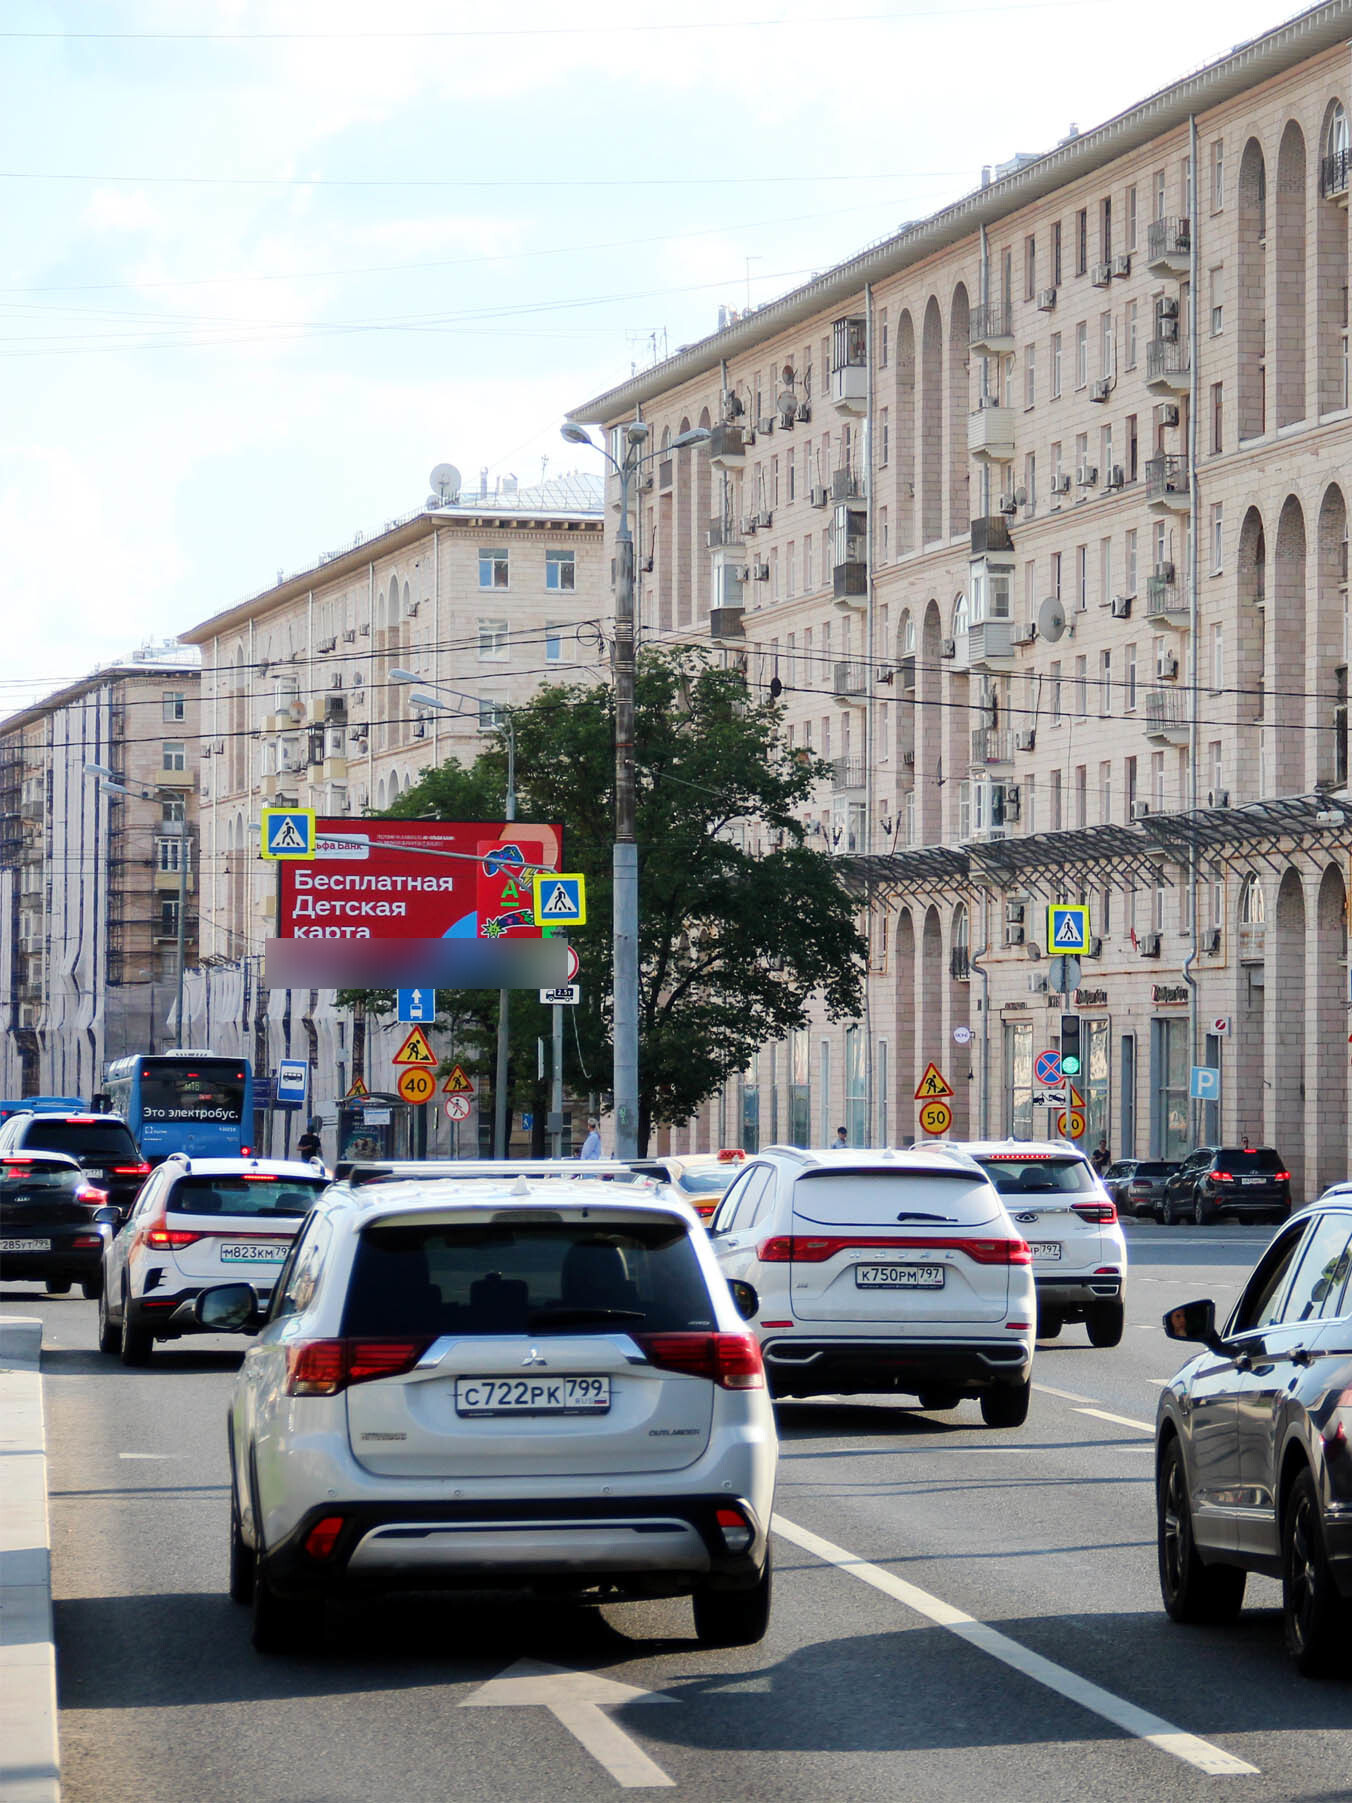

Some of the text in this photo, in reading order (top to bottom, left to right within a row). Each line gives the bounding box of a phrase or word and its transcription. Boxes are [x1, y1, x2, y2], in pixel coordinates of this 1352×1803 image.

[294, 869, 454, 892] Бесплатная
[292, 895, 407, 920] Детская
[293, 924, 371, 938] карта
[404, 1078, 427, 1093] 40
[1196, 1071, 1214, 1095] P
[143, 1107, 239, 1121] Это электробус.
[927, 1111, 946, 1126] 50
[1, 1240, 32, 1250] 285УТ
[223, 1246, 273, 1259] М823КМ
[1042, 1244, 1058, 1254] 797
[862, 1267, 940, 1282] К750РМ 797
[465, 1379, 603, 1406] С722РК 799
